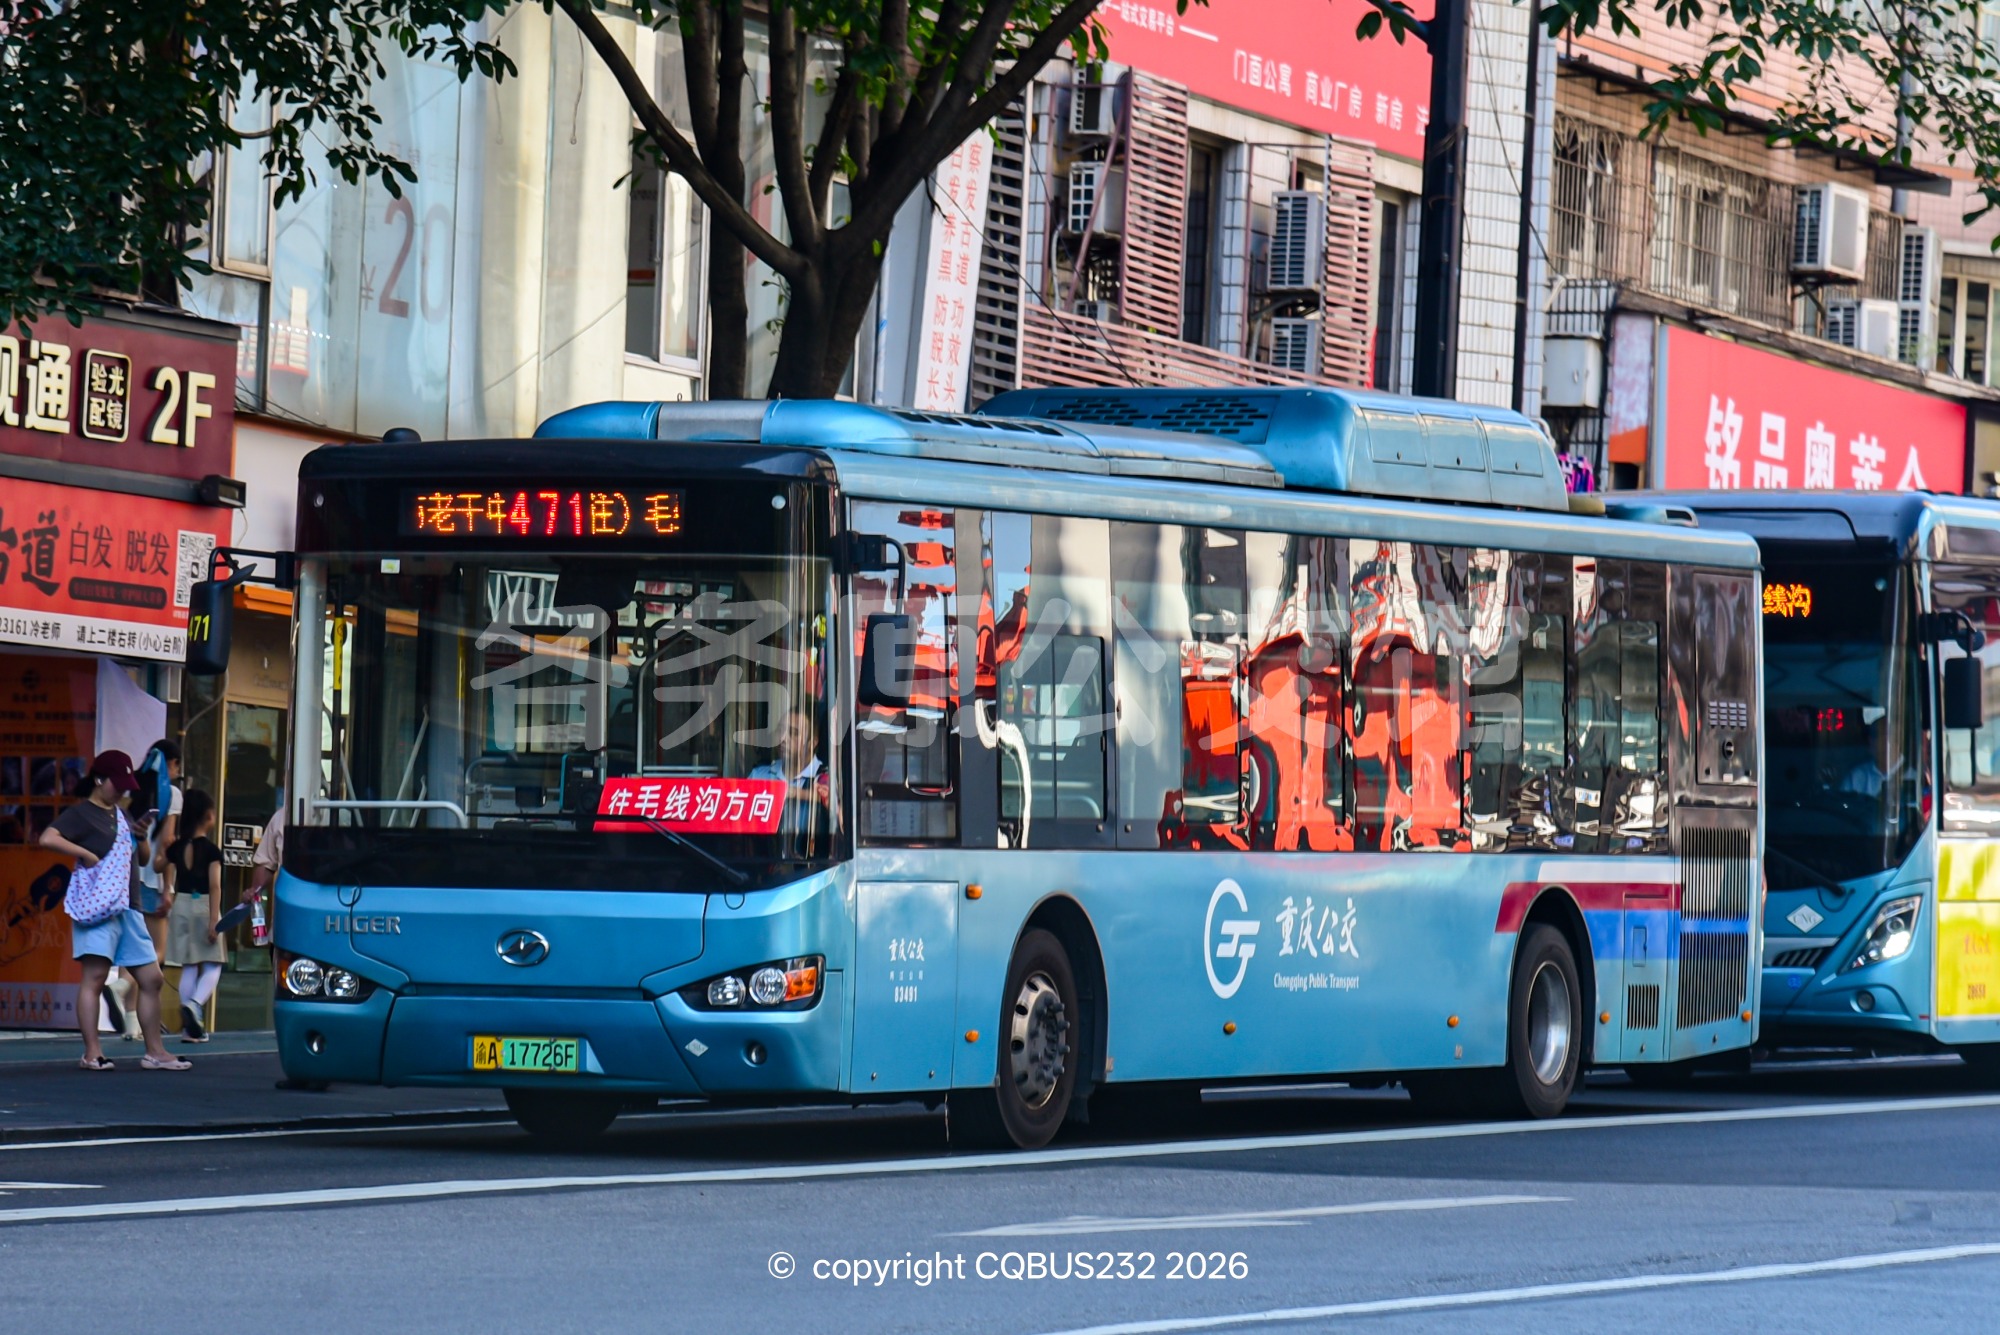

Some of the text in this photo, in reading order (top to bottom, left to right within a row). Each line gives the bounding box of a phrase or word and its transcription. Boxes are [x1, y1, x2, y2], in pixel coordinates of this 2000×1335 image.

[1233, 49, 1292, 97] 门面公寓
[1305, 71, 1362, 119] 商业厂房
[1375, 92, 1403, 132] 新房
[926, 293, 949, 411] 防脱长
[942, 297, 965, 413] 功效头
[91, 362, 124, 396] 验光
[89, 396, 123, 430] 配镜
[151, 366, 216, 448] 2F
[510, 492, 583, 535] 471
[69, 522, 170, 577] 白发 脱发
[29, 620, 61, 641] 冷老师
[607, 784, 775, 823] 往毛线沟方向
[324, 914, 401, 934] HIGER
[1276, 896, 1360, 959] 重庆公交
[889, 937, 925, 962] 重庆公交
[1273, 972, 1360, 992] Chongqing Public Transport
[475, 1041, 575, 1068] 渝A 17726F
